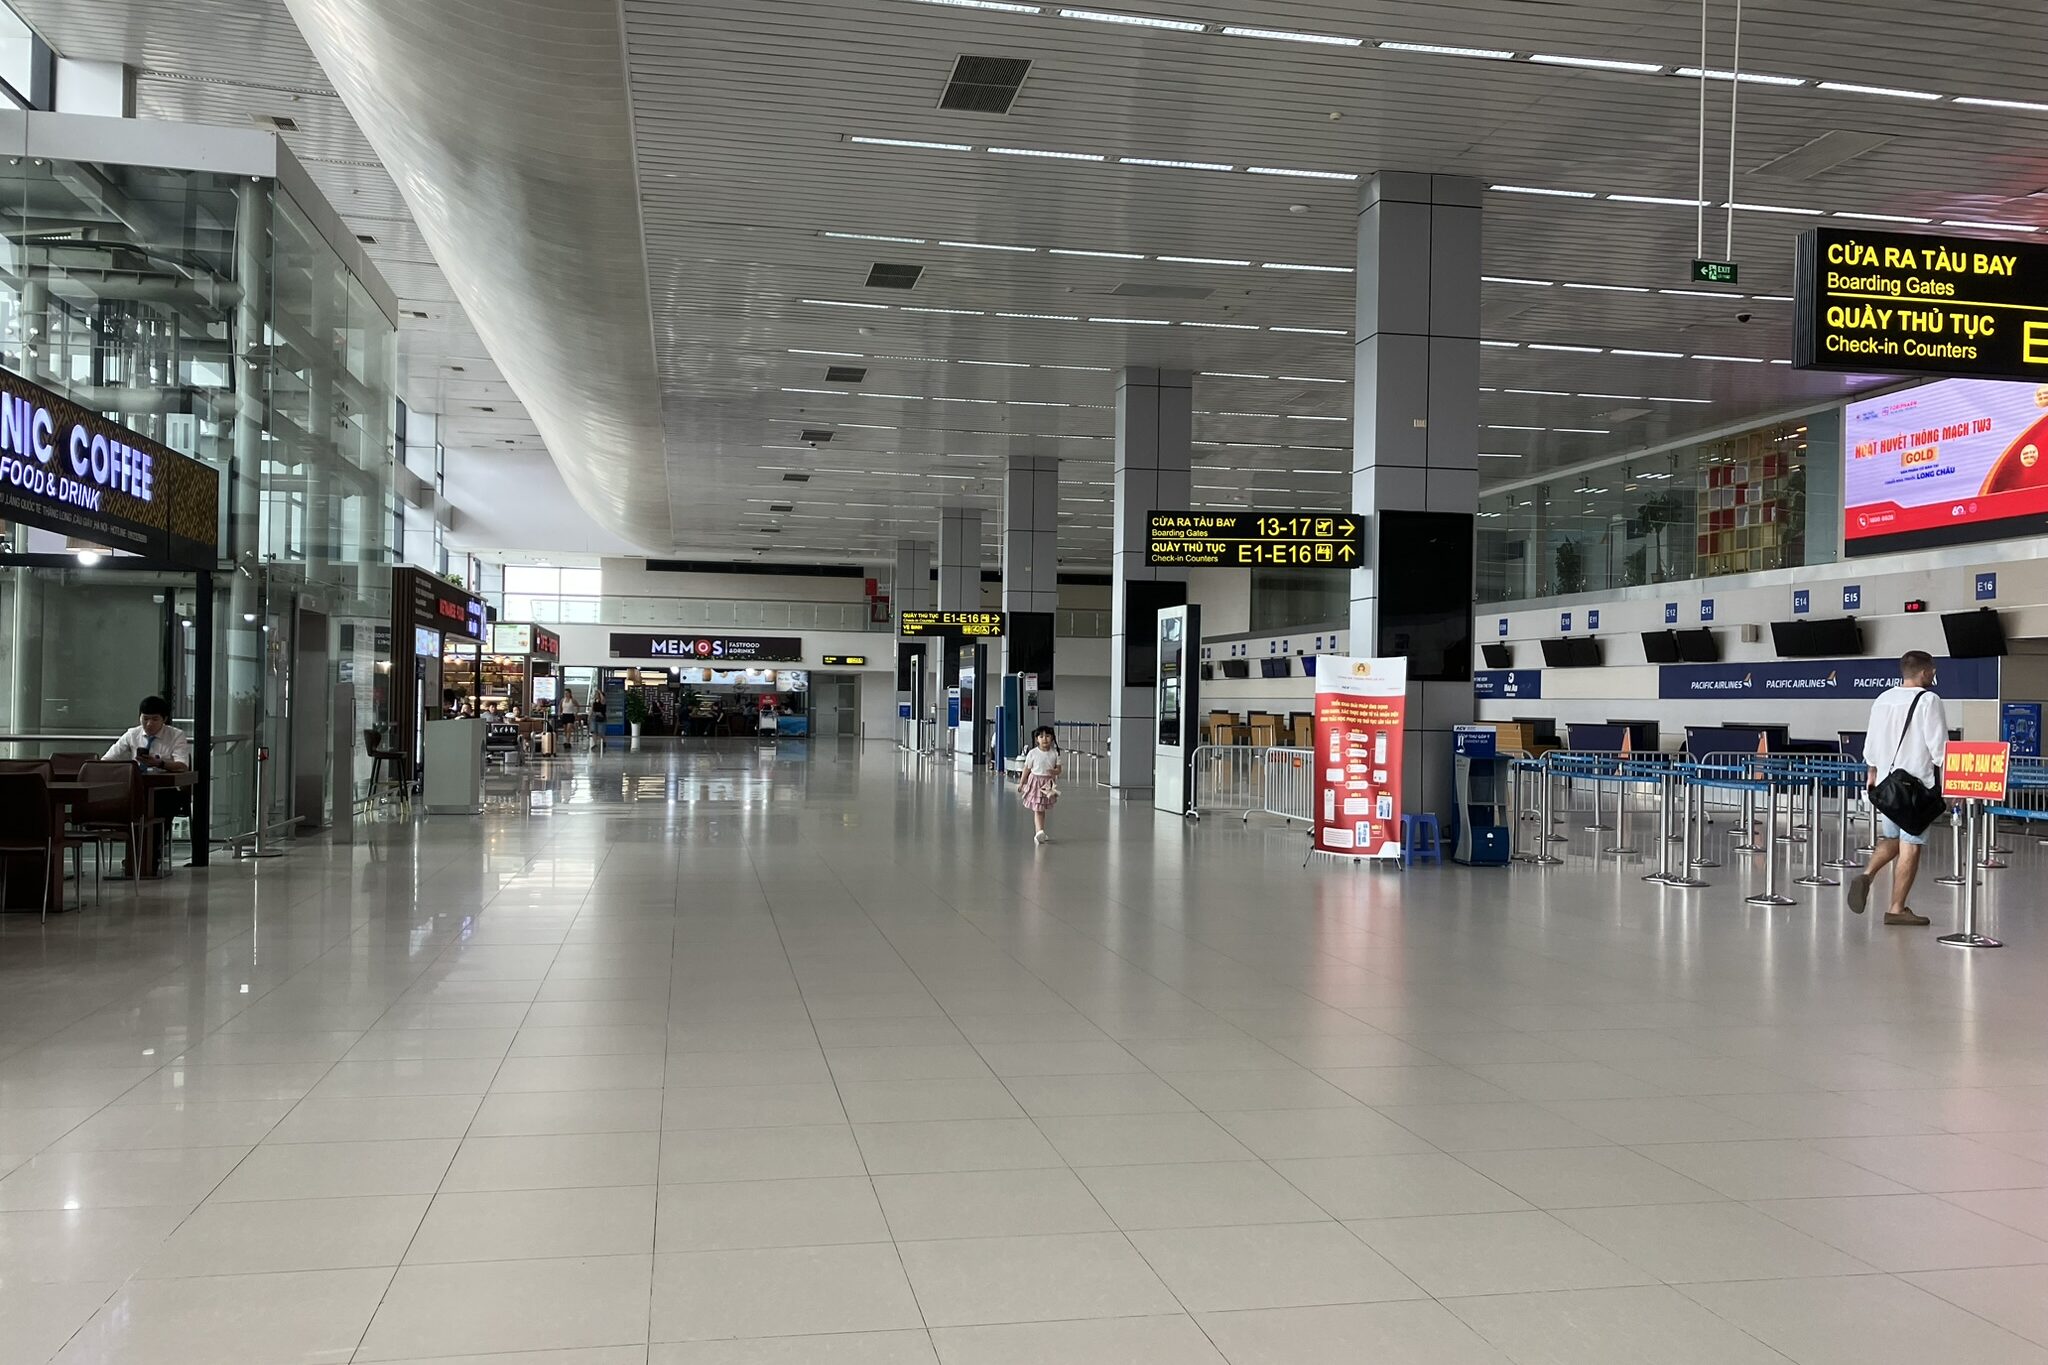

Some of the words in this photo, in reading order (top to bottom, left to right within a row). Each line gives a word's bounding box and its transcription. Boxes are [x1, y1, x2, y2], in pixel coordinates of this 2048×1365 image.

[1828, 240, 1879, 267] CỬA
[1884, 248, 1917, 270] RA
[1922, 246, 1966, 273] TÀU
[1973, 254, 2017, 276] BAY
[1717, 265, 1731, 273] EXIT
[1827, 272, 1901, 296] Boarding
[1906, 277, 1955, 296] Gates
[1826, 304, 1892, 330] QUẦY
[1897, 308, 1943, 333] THỦ
[1950, 314, 1995, 340] TỤC
[1826, 334, 1898, 355] Check-in
[1903, 339, 1977, 360] Counters
[1880, 431, 1908, 453] HUYẾT
[1910, 428, 1939, 448] THÔNG
[1942, 423, 1969, 442] MẠCH
[1973, 418, 1992, 434] TW3
[69, 424, 154, 502] COFFEE
[1905, 449, 1934, 464] GOLD
[1916, 470, 1934, 480] LONG
[1936, 466, 1955, 477] CHÂU
[0, 456, 44, 494] FOOD
[46, 472, 57, 497] &
[58, 477, 101, 512] DRINK
[1152, 516, 1175, 527] CỬA
[1176, 517, 1192, 527] RA
[1194, 516, 1214, 527] TÀU
[1216, 518, 1236, 527] BAY
[1256, 518, 1311, 537] 13-17
[1152, 529, 1185, 538] Boarding
[1186, 529, 1208, 537] Gates
[1151, 554, 1184, 562] Check-in
[1185, 555, 1218, 563] Counters
[1183, 542, 1203, 553] THỦ
[1205, 543, 1226, 556] TỤC
[1238, 544, 1311, 563] E1-E16
[1977, 582, 1993, 592] E16
[1794, 597, 1807, 606] E14
[1844, 593, 1858, 603] E15
[943, 613, 979, 623] E1-E16
[651, 639, 723, 657] MEMOS
[1690, 681, 1714, 689] PACIFIC
[1714, 680, 1743, 689] AIRLINES
[1766, 680, 1792, 688] PACIFIC
[1792, 679, 1826, 688] AIRLINES
[1853, 678, 1884, 687] PACIFIC
[1946, 753, 1961, 772] KHU
[1961, 752, 1974, 777] VỰC
[1974, 754, 1991, 777] HẠN
[1991, 748, 2006, 774] CHẾ
[1945, 780, 1983, 791] RESTRICTED
[1984, 781, 2002, 792] AREA
